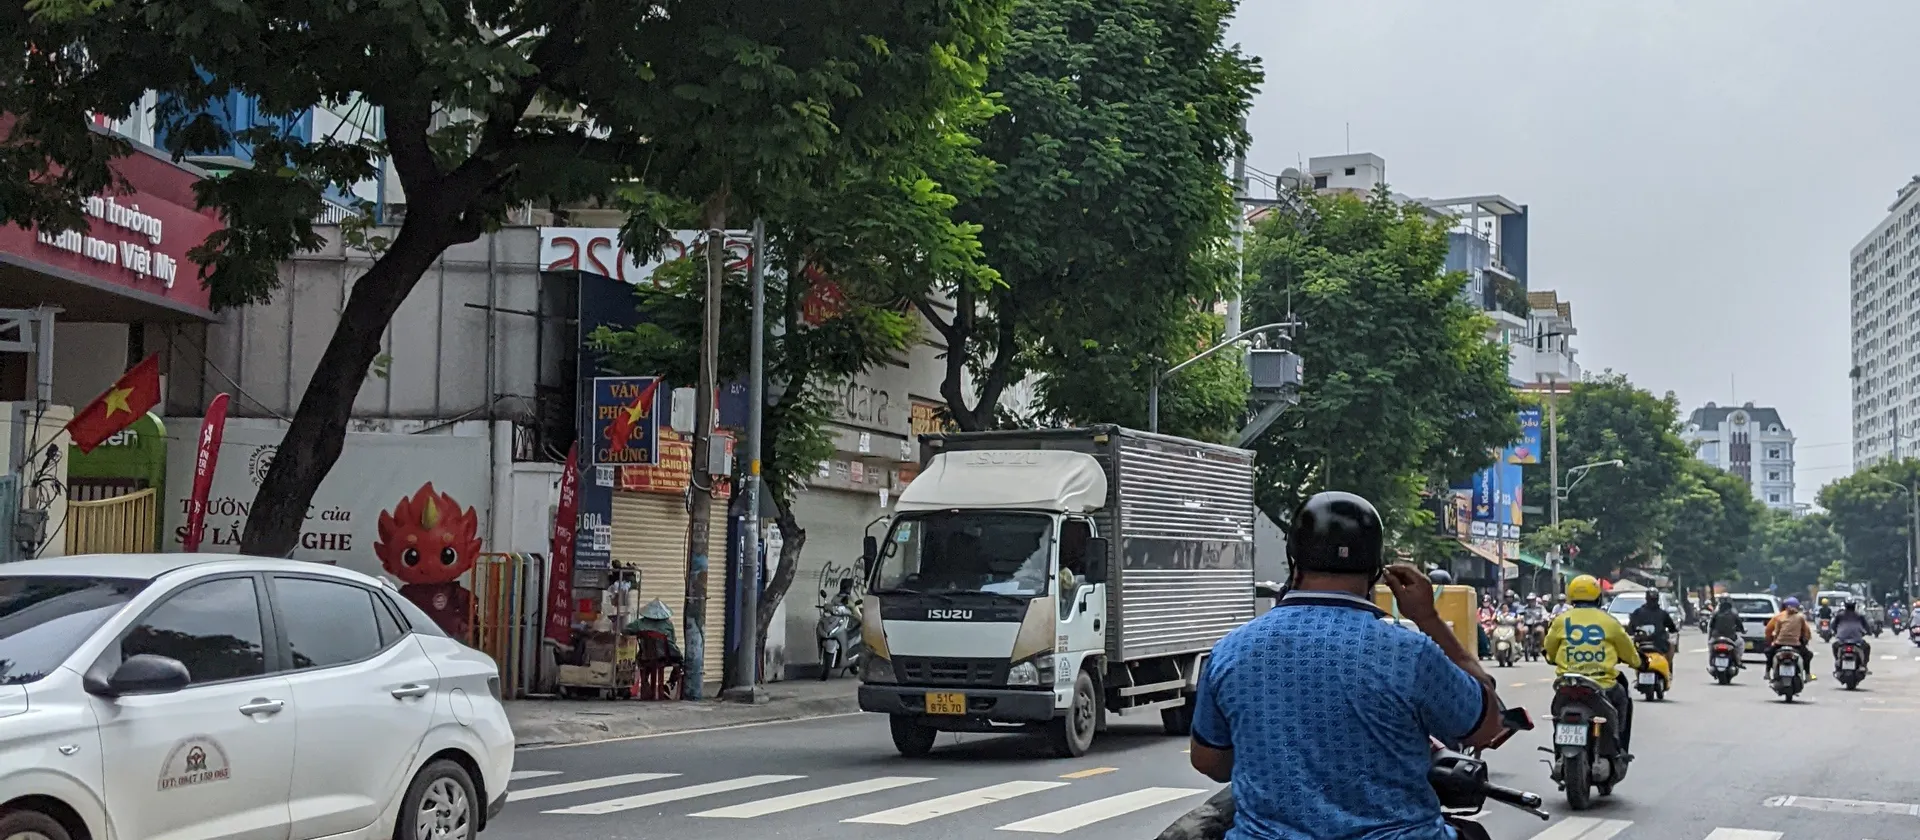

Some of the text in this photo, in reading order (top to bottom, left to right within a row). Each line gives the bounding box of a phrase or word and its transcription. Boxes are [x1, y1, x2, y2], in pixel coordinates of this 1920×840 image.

[105, 196, 162, 245] trường
[83, 235, 117, 265] non
[119, 240, 151, 279] Việt
[153, 252, 177, 289] Mỹ
[610, 381, 640, 398] VĂN
[321, 506, 351, 522] của
[301, 532, 352, 552] GHE
[928, 609, 973, 620] ISUZU
[1564, 617, 1606, 646] be
[1566, 646, 1606, 662] Food
[937, 693, 954, 703] 51C
